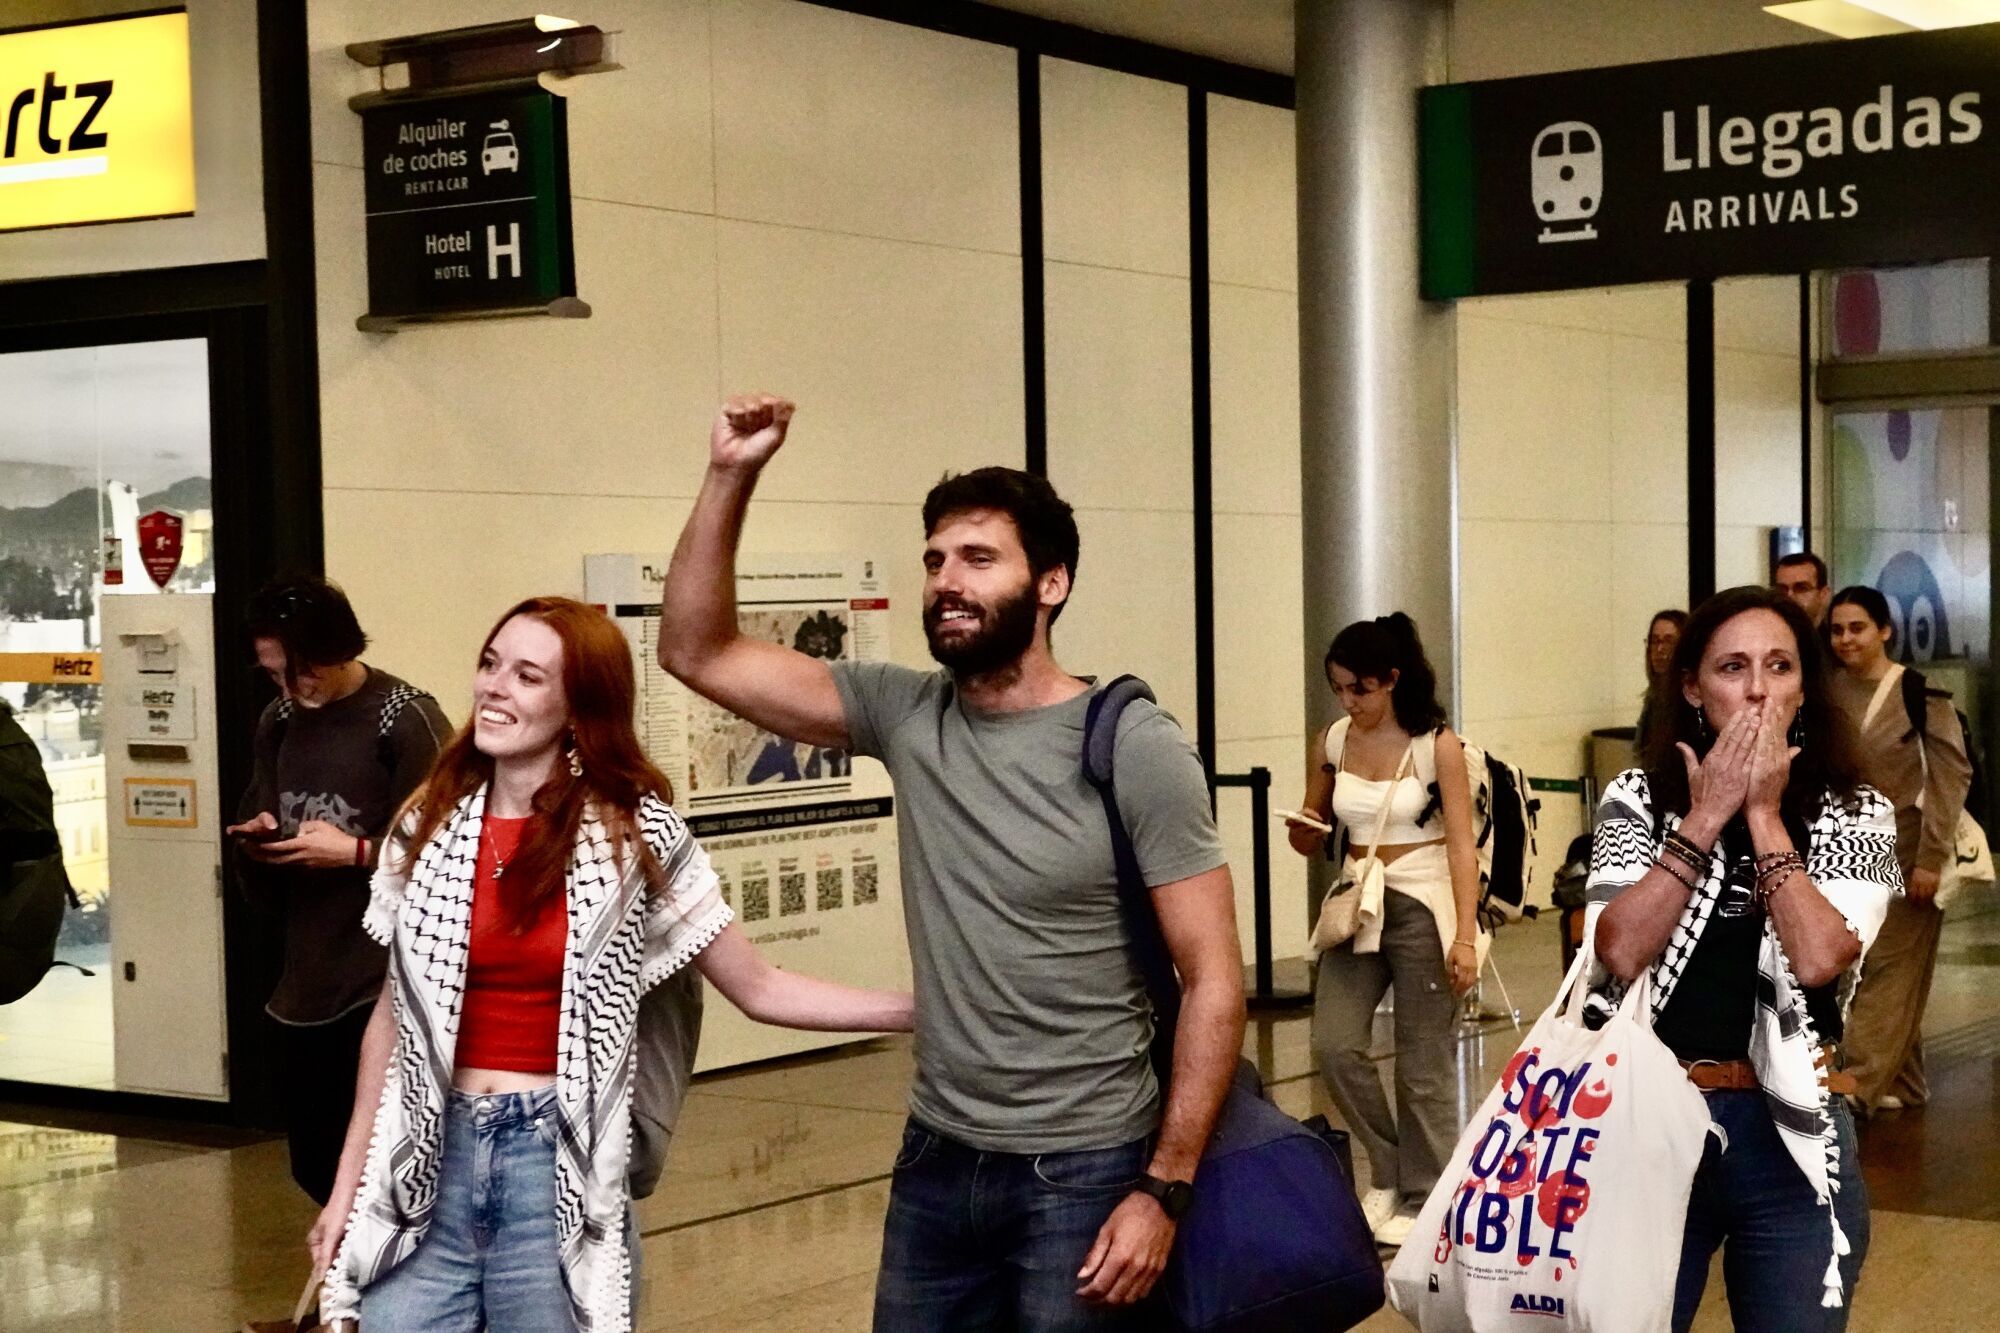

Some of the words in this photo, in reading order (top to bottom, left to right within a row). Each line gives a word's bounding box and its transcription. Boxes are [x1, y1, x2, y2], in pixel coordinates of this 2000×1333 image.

[0, 70, 114, 159] rtz
[398, 118, 467, 147] Alquiler
[1662, 84, 1983, 179] Llegadas
[383, 153, 405, 174] de
[410, 148, 468, 171] coches
[404, 180, 435, 195] RENT
[436, 180, 445, 192] A
[446, 177, 469, 191] CAR
[1664, 184, 1859, 233] ARRIVALS
[425, 230, 472, 255] Hotel
[486, 222, 522, 280] H
[434, 265, 472, 280] HOTEL
[53, 656, 94, 677] Hertz
[142, 688, 175, 705] Hertz
[1502, 1053, 1593, 1120] SOY
[1469, 1118, 1601, 1187] OSTE
[1444, 1186, 1583, 1260] IBLE
[1510, 1293, 1565, 1316] ALDI
